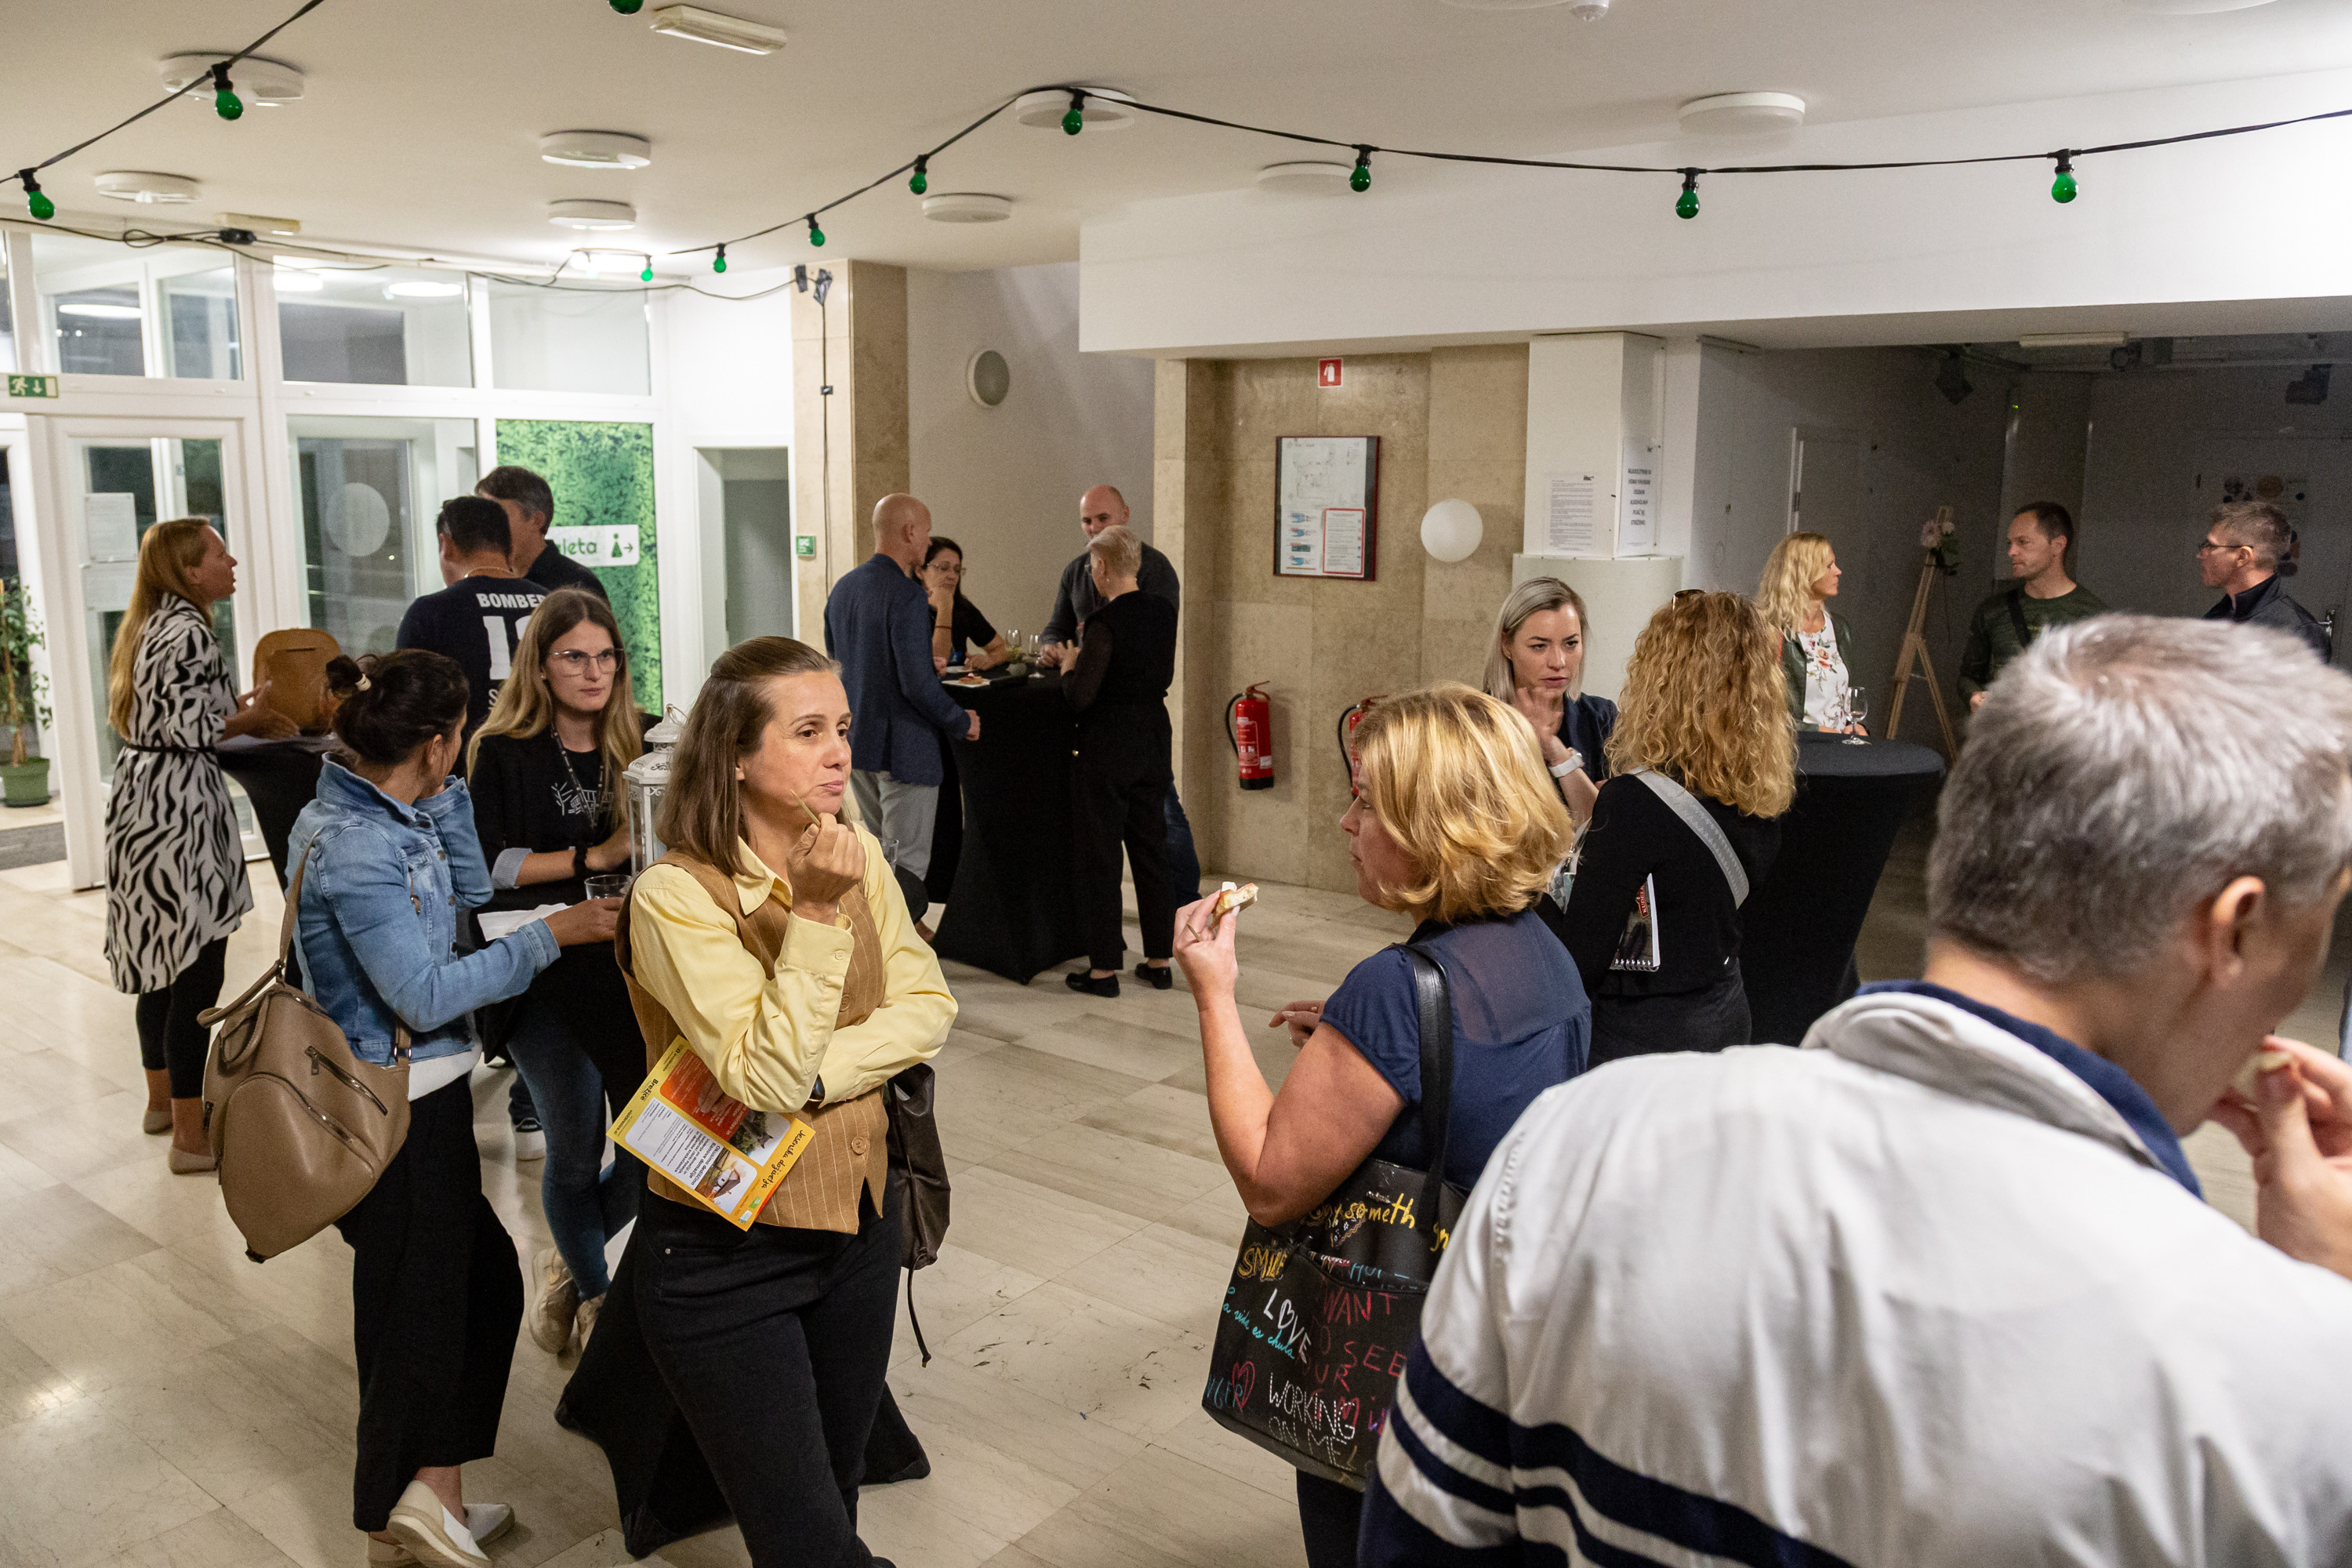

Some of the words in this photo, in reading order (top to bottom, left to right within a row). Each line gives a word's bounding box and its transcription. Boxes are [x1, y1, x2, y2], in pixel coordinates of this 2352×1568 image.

[555, 538, 597, 555] leta
[640, 1078, 659, 1102] Brežice
[705, 1145, 720, 1166] Okusimo
[782, 1129, 807, 1161] Jesenska
[688, 1158, 705, 1179] domačije
[691, 1164, 707, 1186] dediščino
[760, 1157, 786, 1190] doživetja
[1236, 1244, 1288, 1280] SMILE
[1323, 1287, 1399, 1326] WANT
[1263, 1288, 1312, 1364] LOVE
[1268, 1372, 1356, 1441] WORKING
